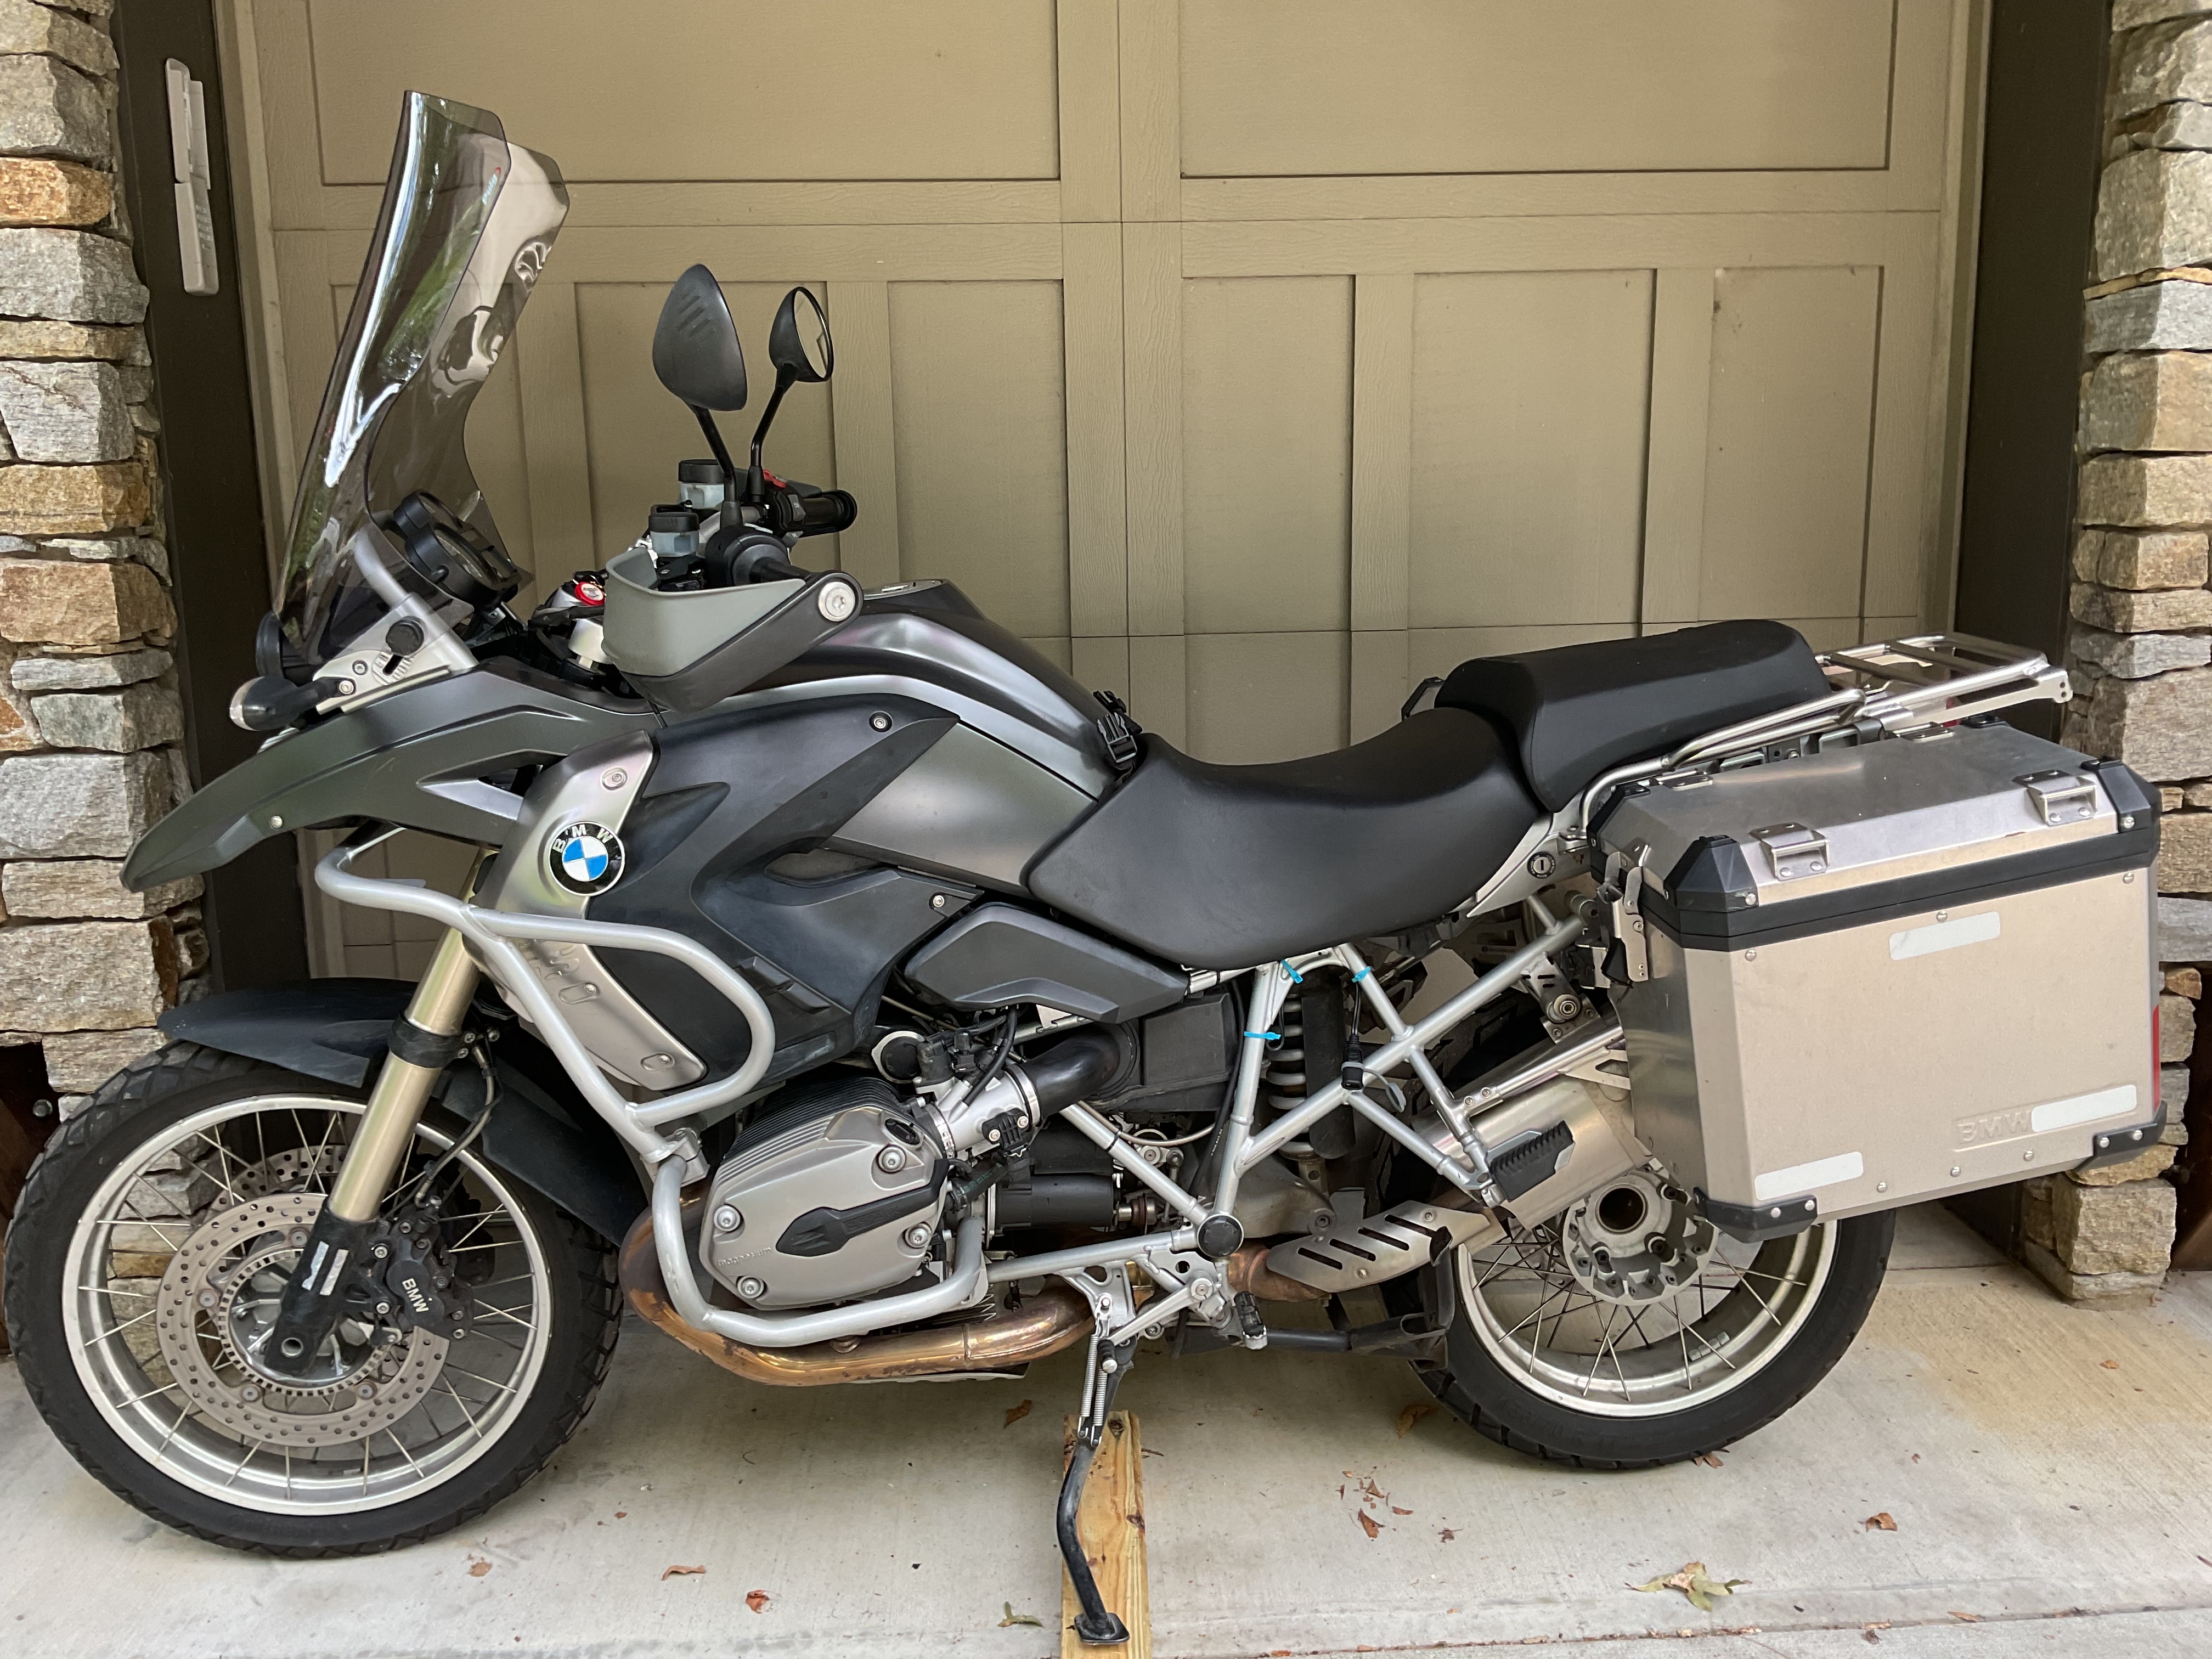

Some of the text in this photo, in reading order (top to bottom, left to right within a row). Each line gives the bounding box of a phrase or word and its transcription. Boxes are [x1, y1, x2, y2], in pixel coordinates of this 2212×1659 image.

[552, 824, 613, 853] BMW
[1957, 1110, 2032, 1145] BMW
[715, 1247, 771, 1266] magnesium
[402, 1278, 429, 1312] BMW
